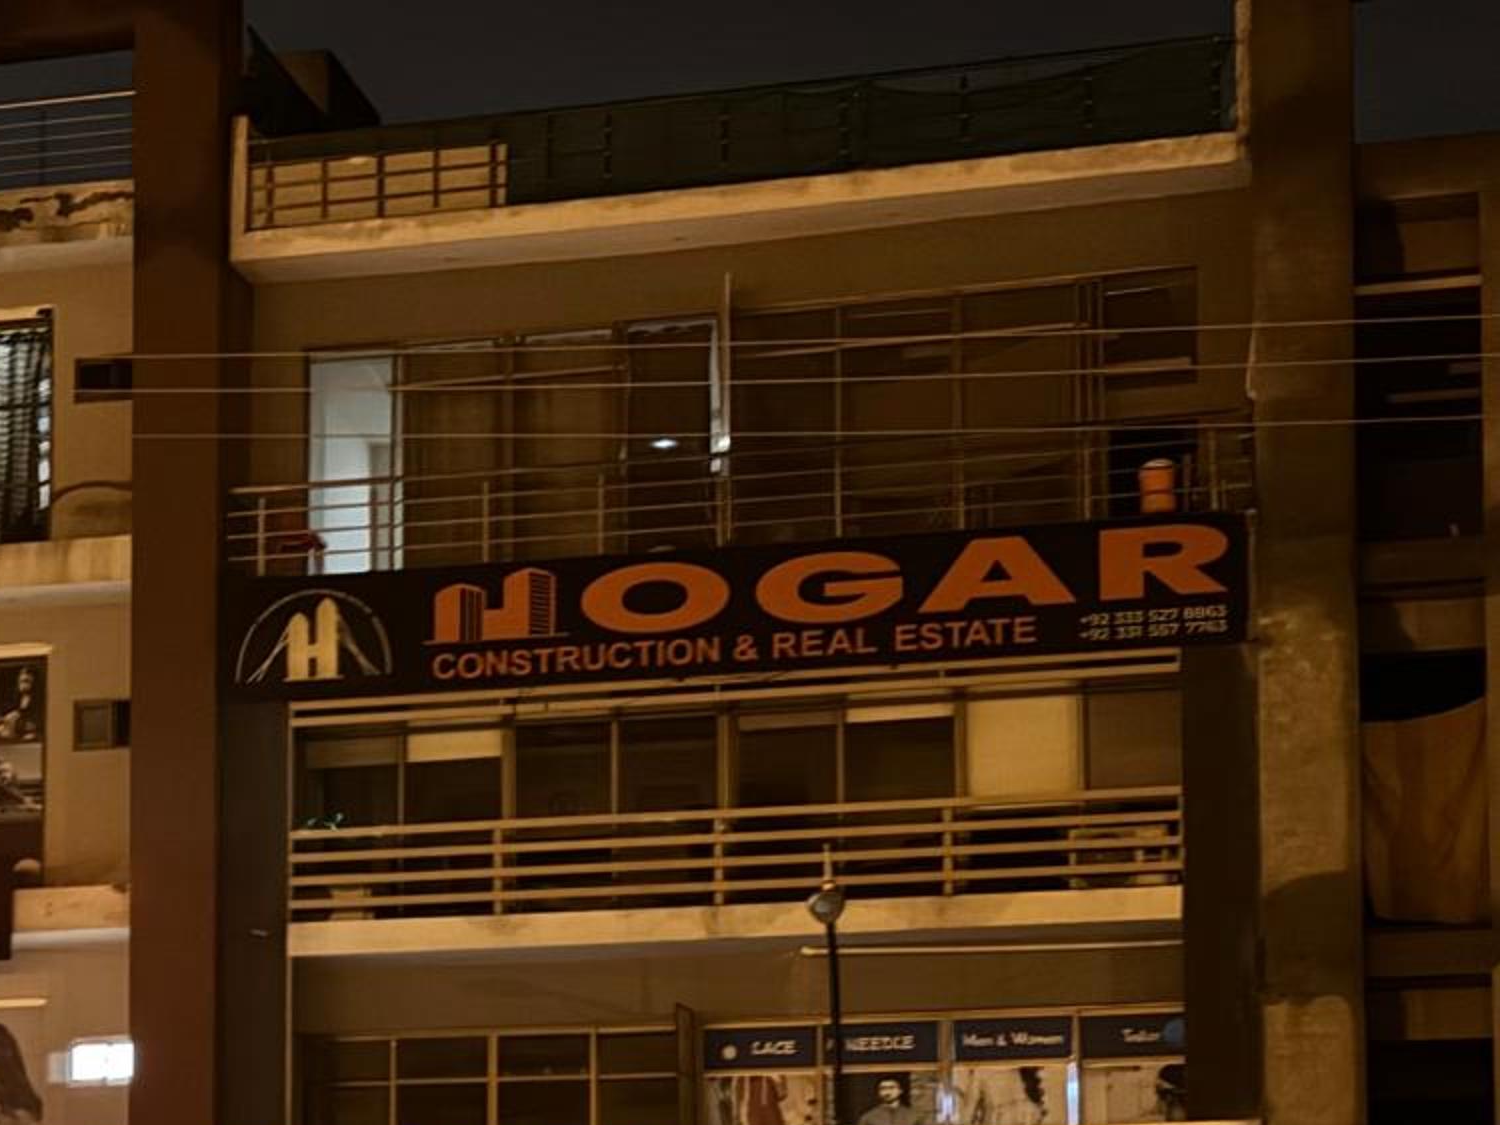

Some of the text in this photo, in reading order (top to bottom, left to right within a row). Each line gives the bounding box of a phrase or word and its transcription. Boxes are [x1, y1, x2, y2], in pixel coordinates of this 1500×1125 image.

[432, 615, 1039, 680] CONSTRUCTION & REAL ESTATE
